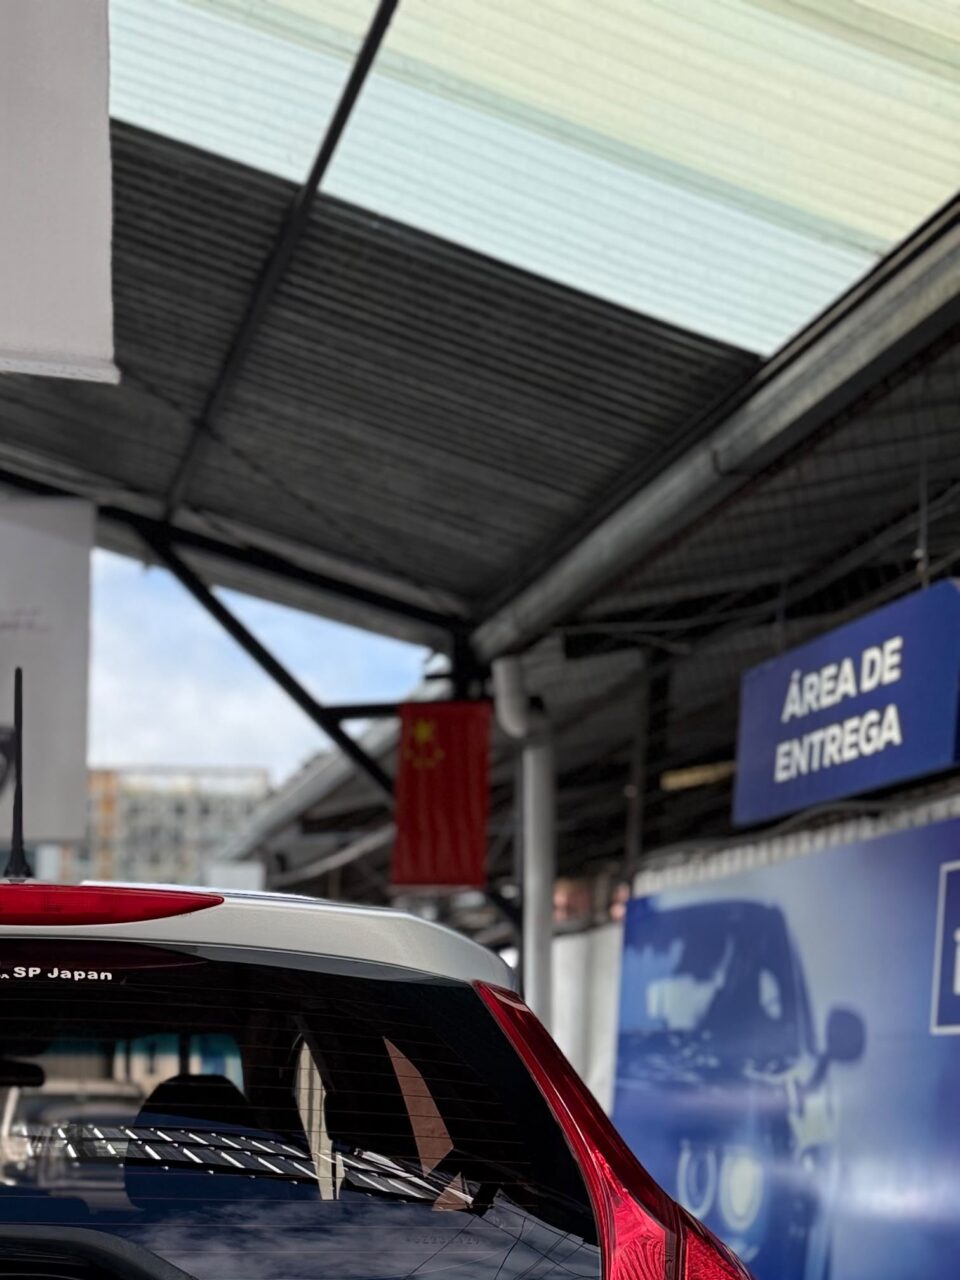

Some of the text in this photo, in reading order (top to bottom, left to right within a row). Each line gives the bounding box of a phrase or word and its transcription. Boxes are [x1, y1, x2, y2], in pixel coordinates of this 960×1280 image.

[781, 636, 903, 723] ÁREA DE
[774, 703, 902, 783] ENTREGA
[13, 966, 41, 978] SP
[47, 968, 113, 981] Japan
